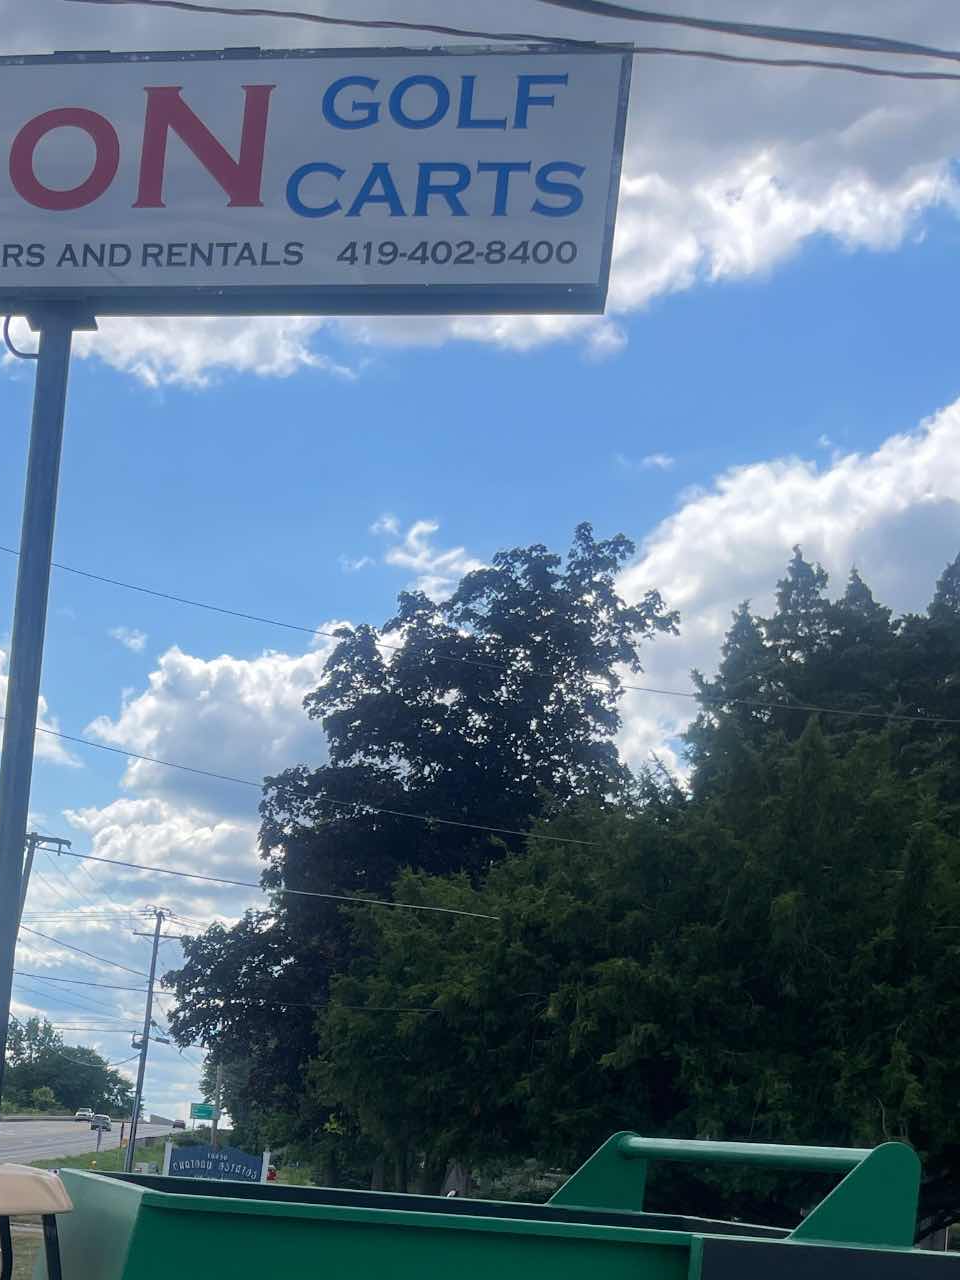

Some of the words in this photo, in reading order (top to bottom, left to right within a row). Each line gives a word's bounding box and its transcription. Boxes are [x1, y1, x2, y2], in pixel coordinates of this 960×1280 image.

[322, 73, 568, 130] GOLF
[286, 161, 586, 218] CARTS
[56, 243, 132, 268] AND
[141, 242, 304, 267] RENTALS
[336, 240, 577, 265] 419-402-8400
